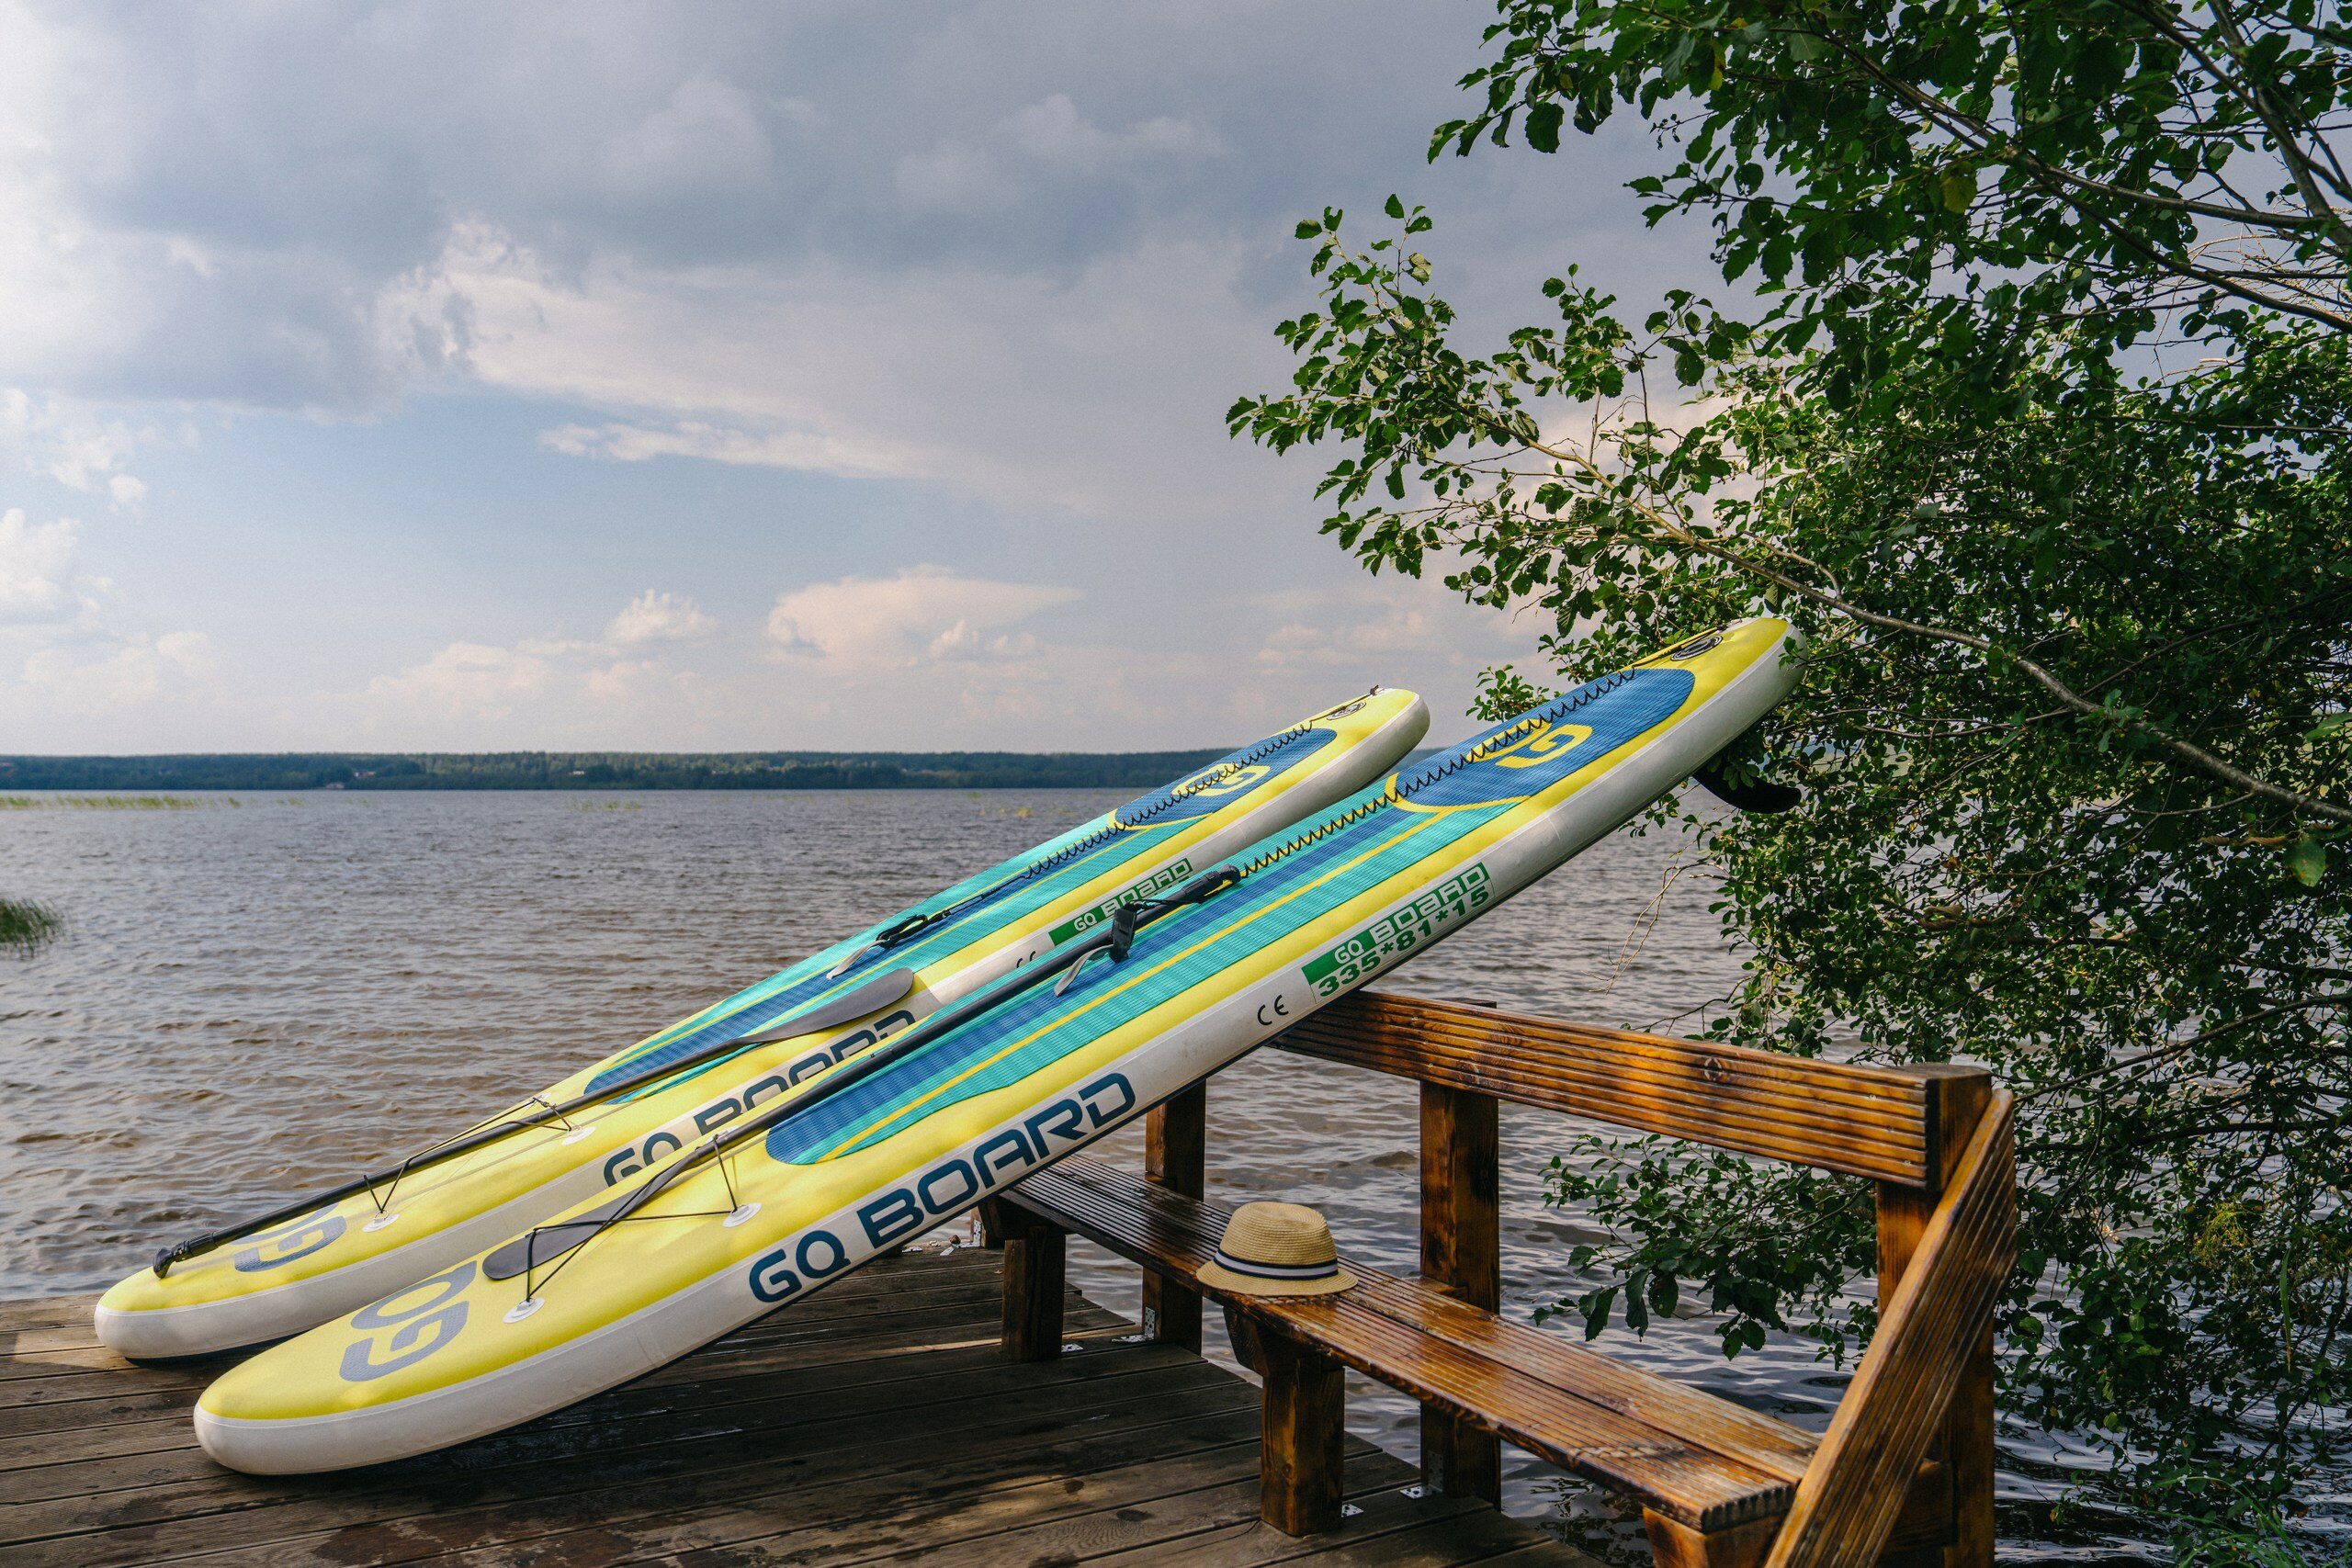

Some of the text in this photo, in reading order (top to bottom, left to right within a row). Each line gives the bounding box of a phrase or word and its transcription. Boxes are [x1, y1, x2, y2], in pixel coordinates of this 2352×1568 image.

[1074, 912, 1096, 932] GQ
[1334, 940, 1364, 964] GQ
[750, 1072, 1136, 1303] GQ BOARD
